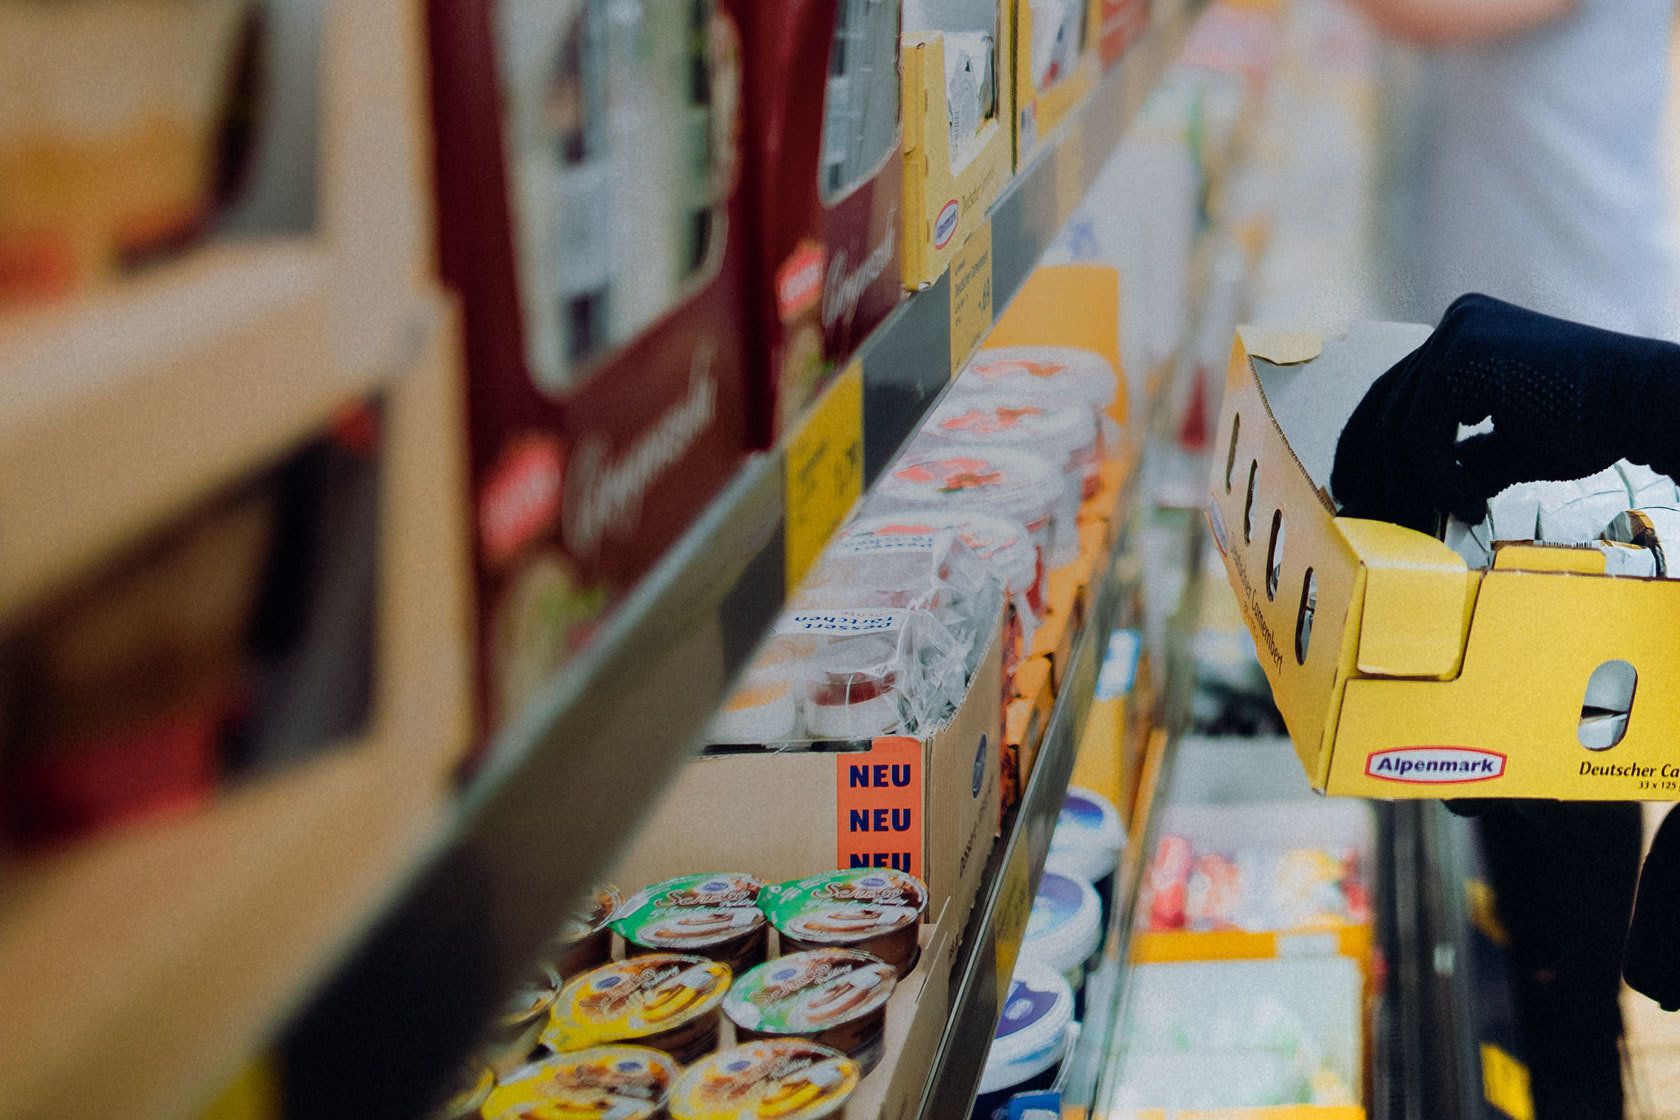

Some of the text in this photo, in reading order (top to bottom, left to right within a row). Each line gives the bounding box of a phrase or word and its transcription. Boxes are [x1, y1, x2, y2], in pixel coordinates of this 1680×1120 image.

[1252, 589, 1283, 675] Camembert
[1377, 757, 1493, 773] Alpenmark
[1579, 761, 1658, 778] Deutscher
[849, 764, 911, 788] NEU
[1661, 781, 1676, 790] 125
[849, 808, 911, 832] NEU
